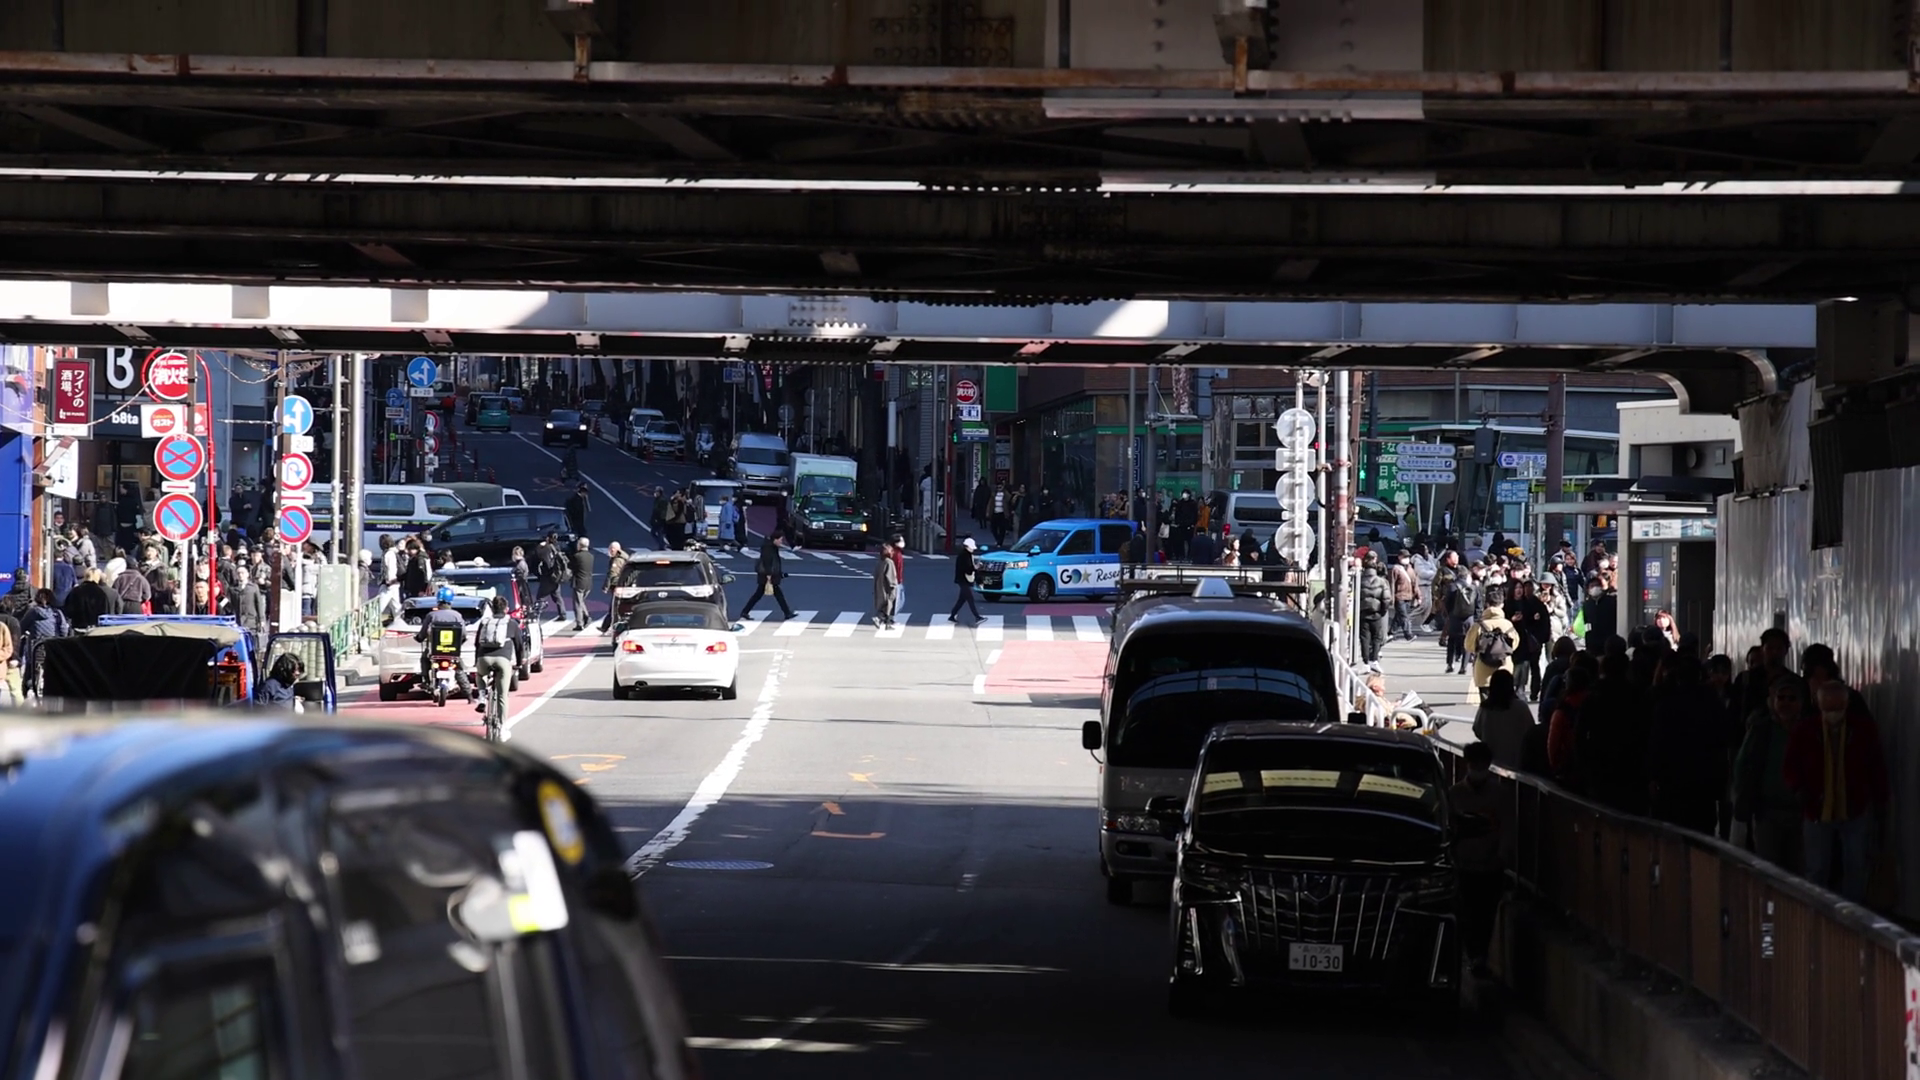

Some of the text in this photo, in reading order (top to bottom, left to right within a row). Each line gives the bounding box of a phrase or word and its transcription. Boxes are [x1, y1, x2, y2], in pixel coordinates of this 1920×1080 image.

[61, 370, 72, 397] 酒場。
[73, 370, 85, 407] ワインの
[957, 388, 974, 396] 消火栓
[112, 411, 138, 424] b8ta
[1302, 954, 1340, 970] 10-30
